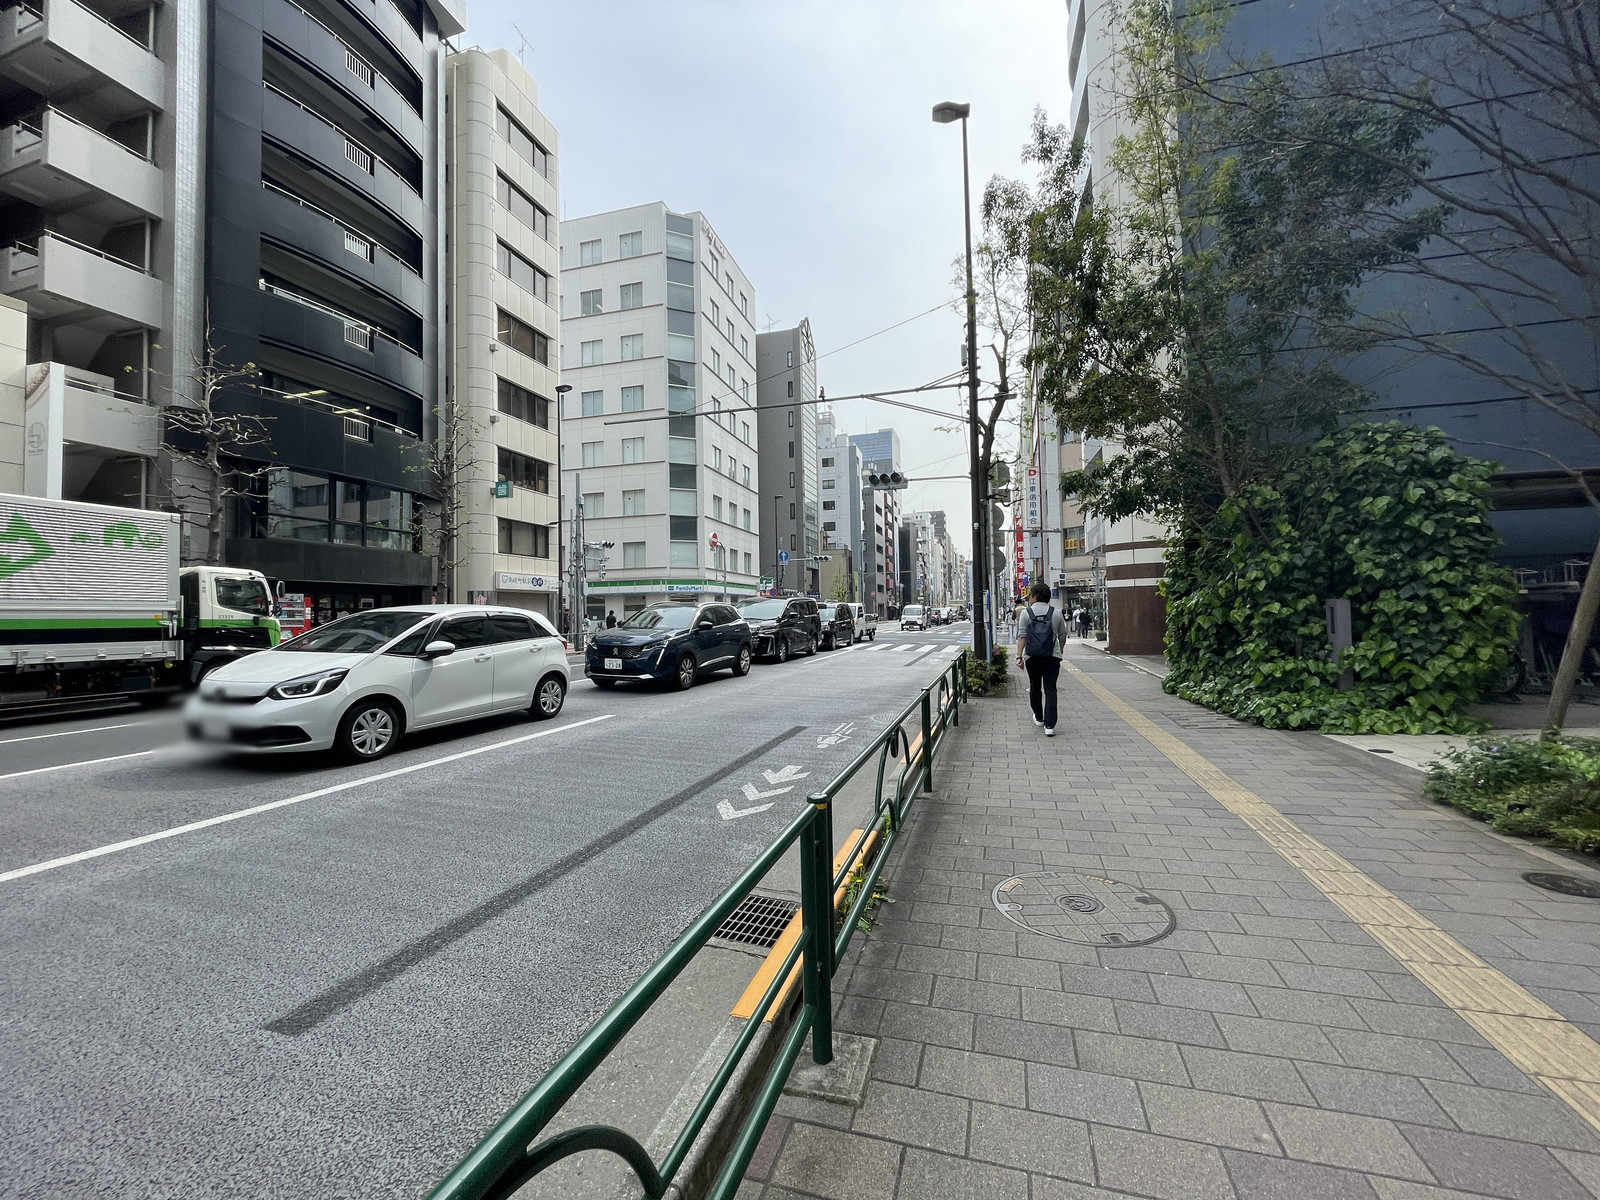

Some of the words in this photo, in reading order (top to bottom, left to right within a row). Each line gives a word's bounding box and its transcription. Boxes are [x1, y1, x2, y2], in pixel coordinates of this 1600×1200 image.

[1029, 478, 1037, 525] 江東信用組合
